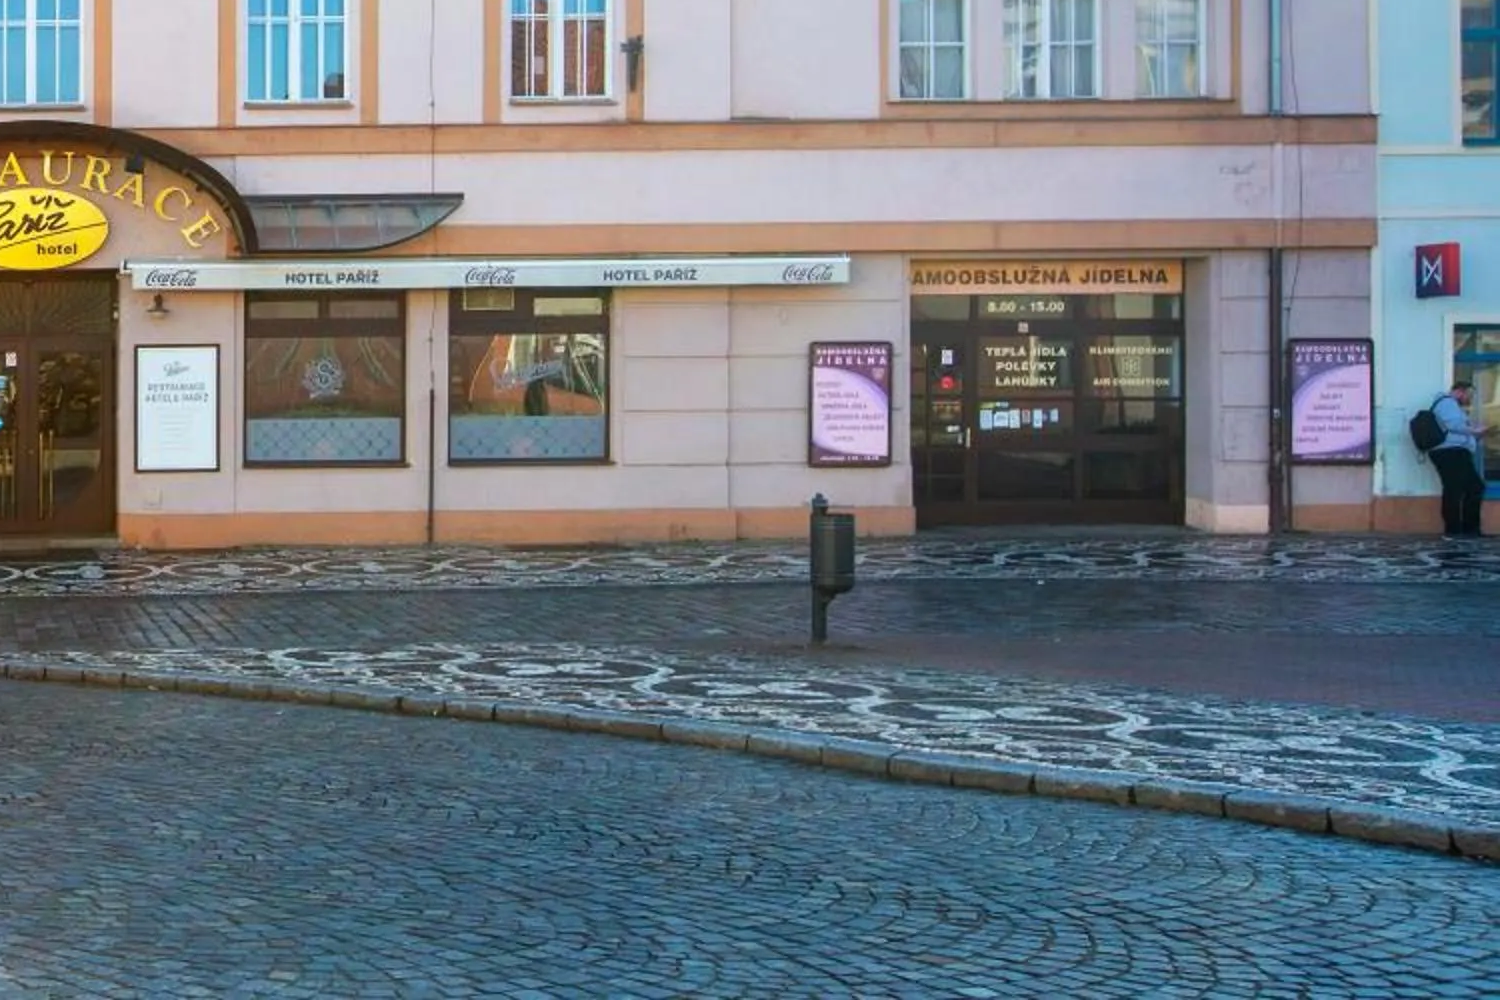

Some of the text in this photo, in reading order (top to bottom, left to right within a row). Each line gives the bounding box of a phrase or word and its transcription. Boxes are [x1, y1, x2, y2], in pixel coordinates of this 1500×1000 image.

[36, 242, 78, 256] hotel
[285, 269, 380, 285] HOTEL PAŘÍŽ
[603, 266, 698, 281] HOTEL PAŘÍŽ
[1079, 267, 1169, 284] JÍDELNA
